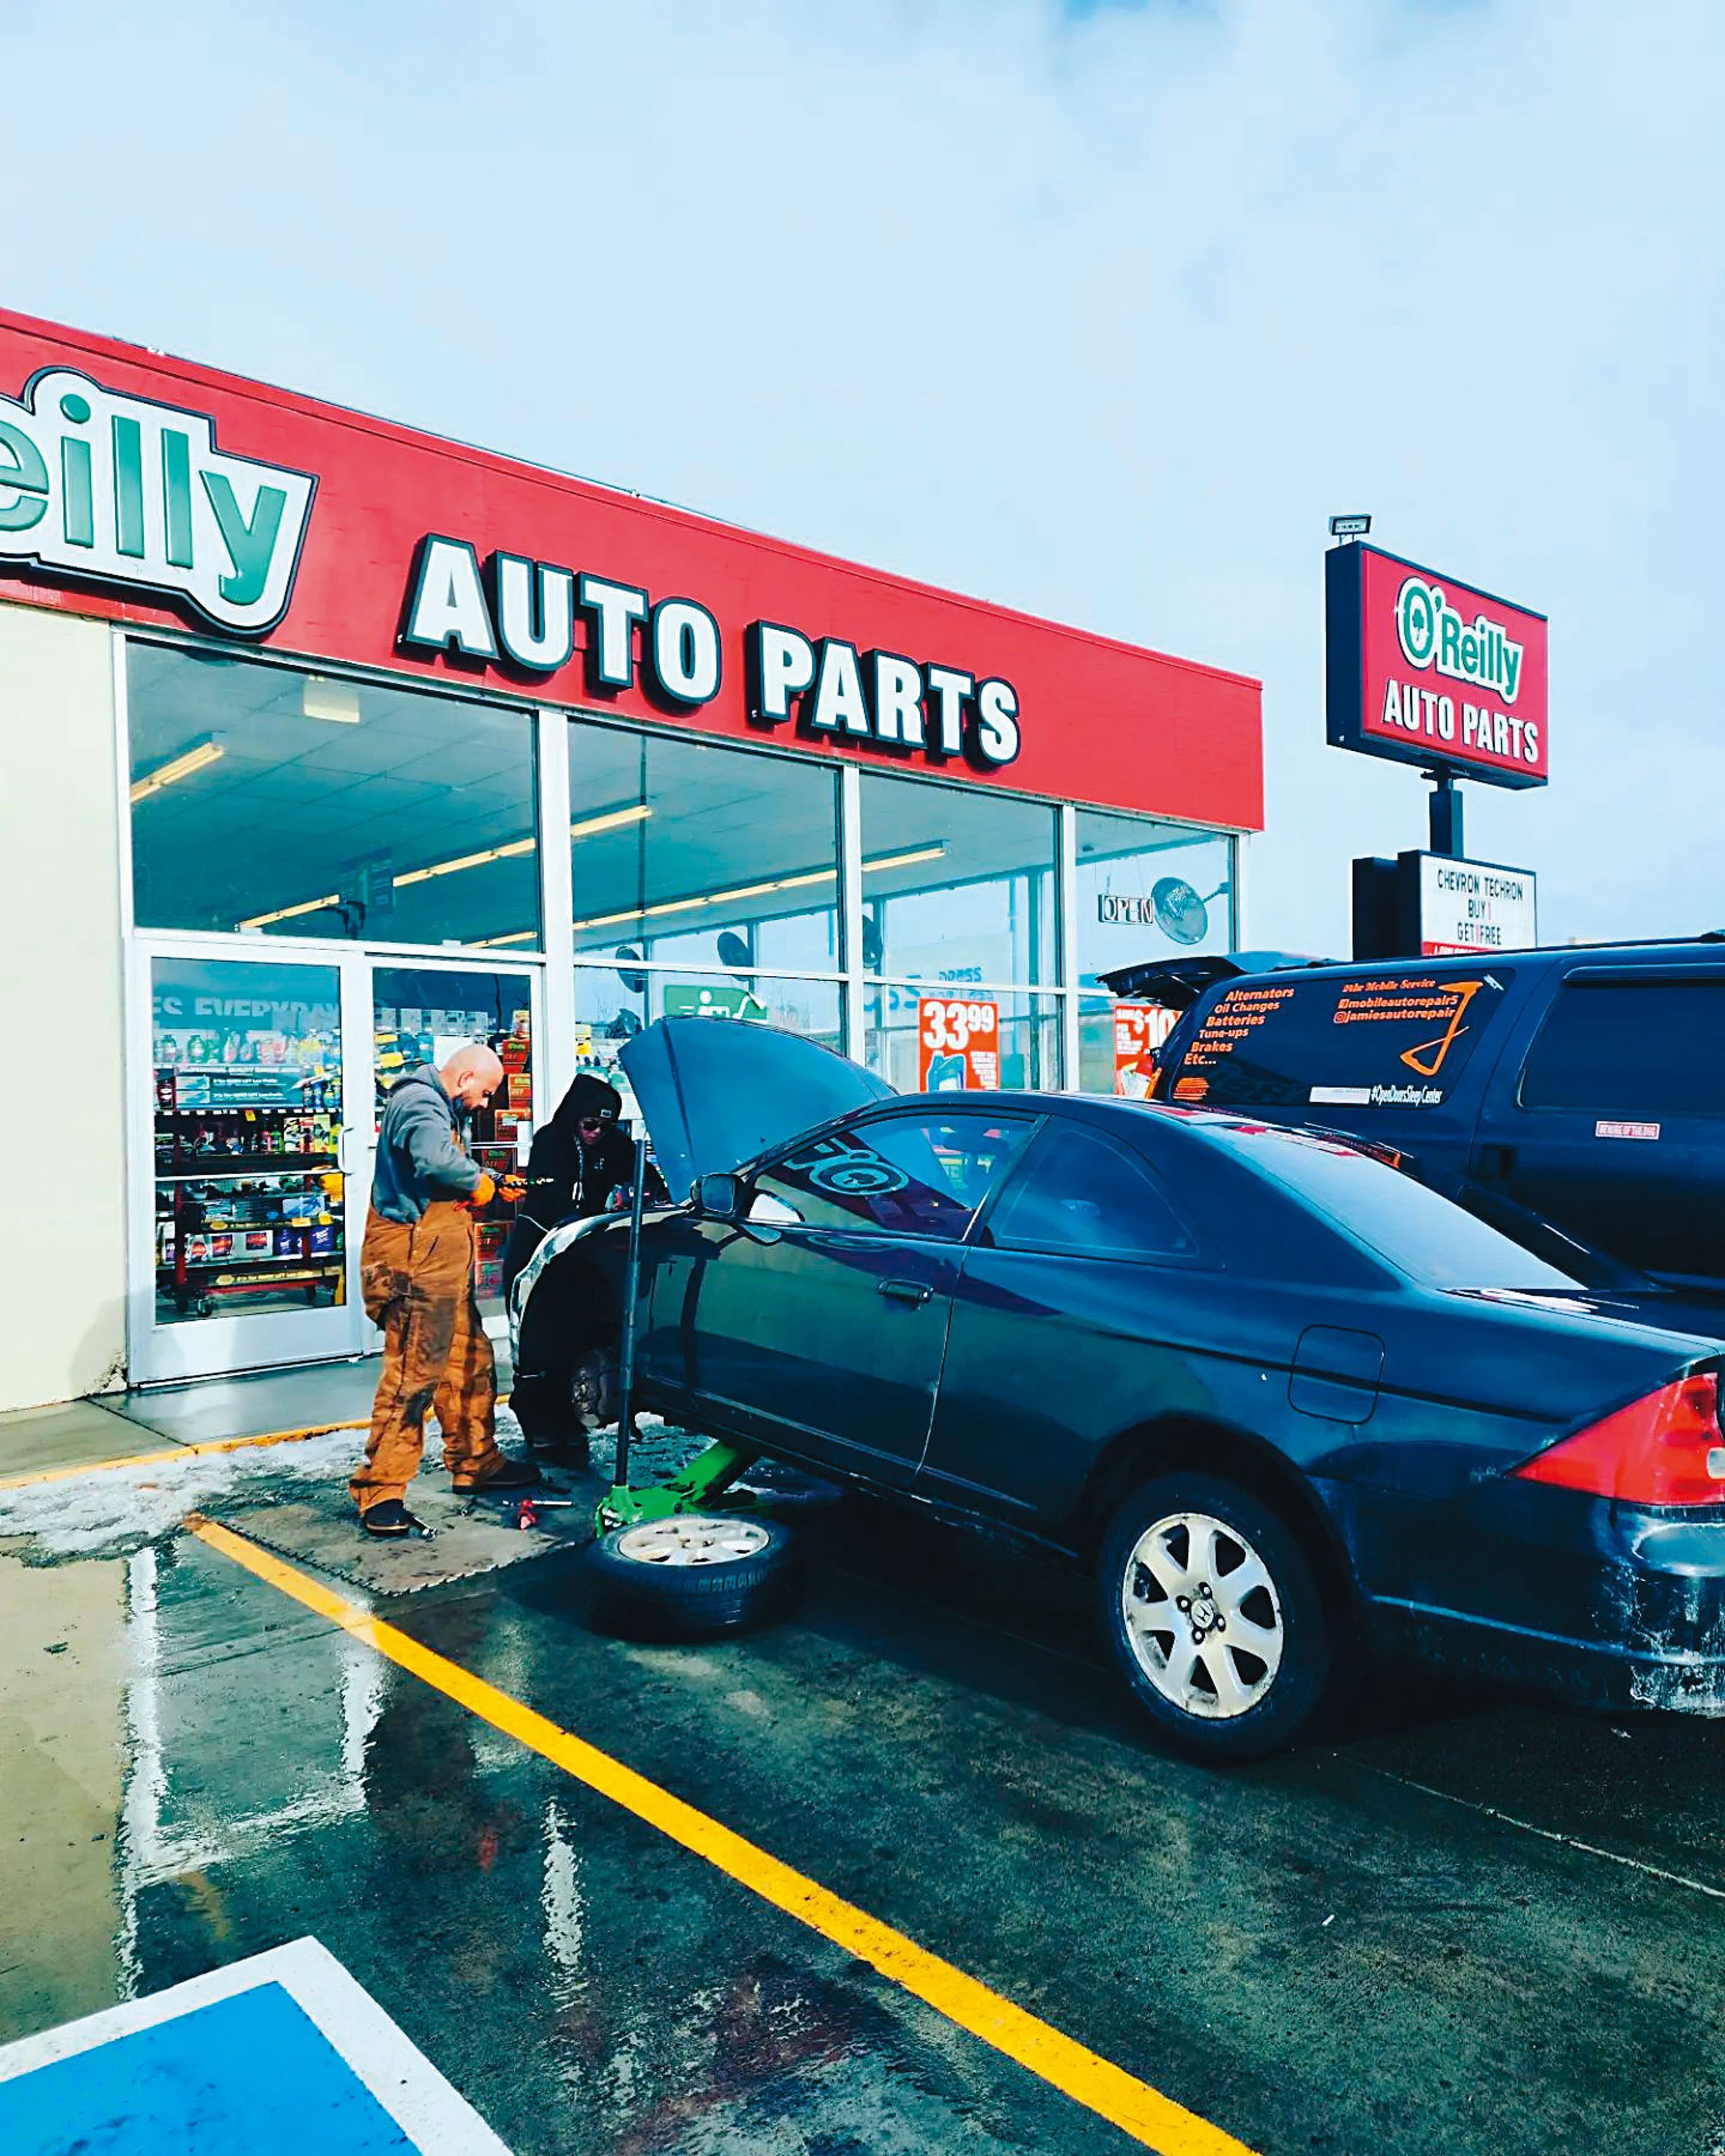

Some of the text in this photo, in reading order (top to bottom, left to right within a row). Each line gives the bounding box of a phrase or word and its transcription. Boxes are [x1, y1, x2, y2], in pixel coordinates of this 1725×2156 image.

[402, 533, 1021, 764] AUTO PARTS
[1400, 579, 1522, 700] O'Reilly
[1383, 679, 1539, 764] AUTO PARTS
[1437, 868, 1523, 901] CHEVRON TECHRON
[1104, 896, 1153, 923] OPEN
[1468, 898, 1486, 918] BUY
[1457, 921, 1474, 940] GET
[1480, 925, 1501, 946] FREE
[1399, 979, 1436, 989] Service
[1225, 988, 1294, 1002] Alternators
[1214, 1001, 1280, 1014] Oil Changes
[1206, 1013, 1266, 1027] Batteries
[1199, 1028, 1249, 1040] Tune-ups
[1190, 1041, 1233, 1053] Brakes
[1183, 1053, 1217, 1065] Etc...
[1421, 1084, 1443, 1104] Center
